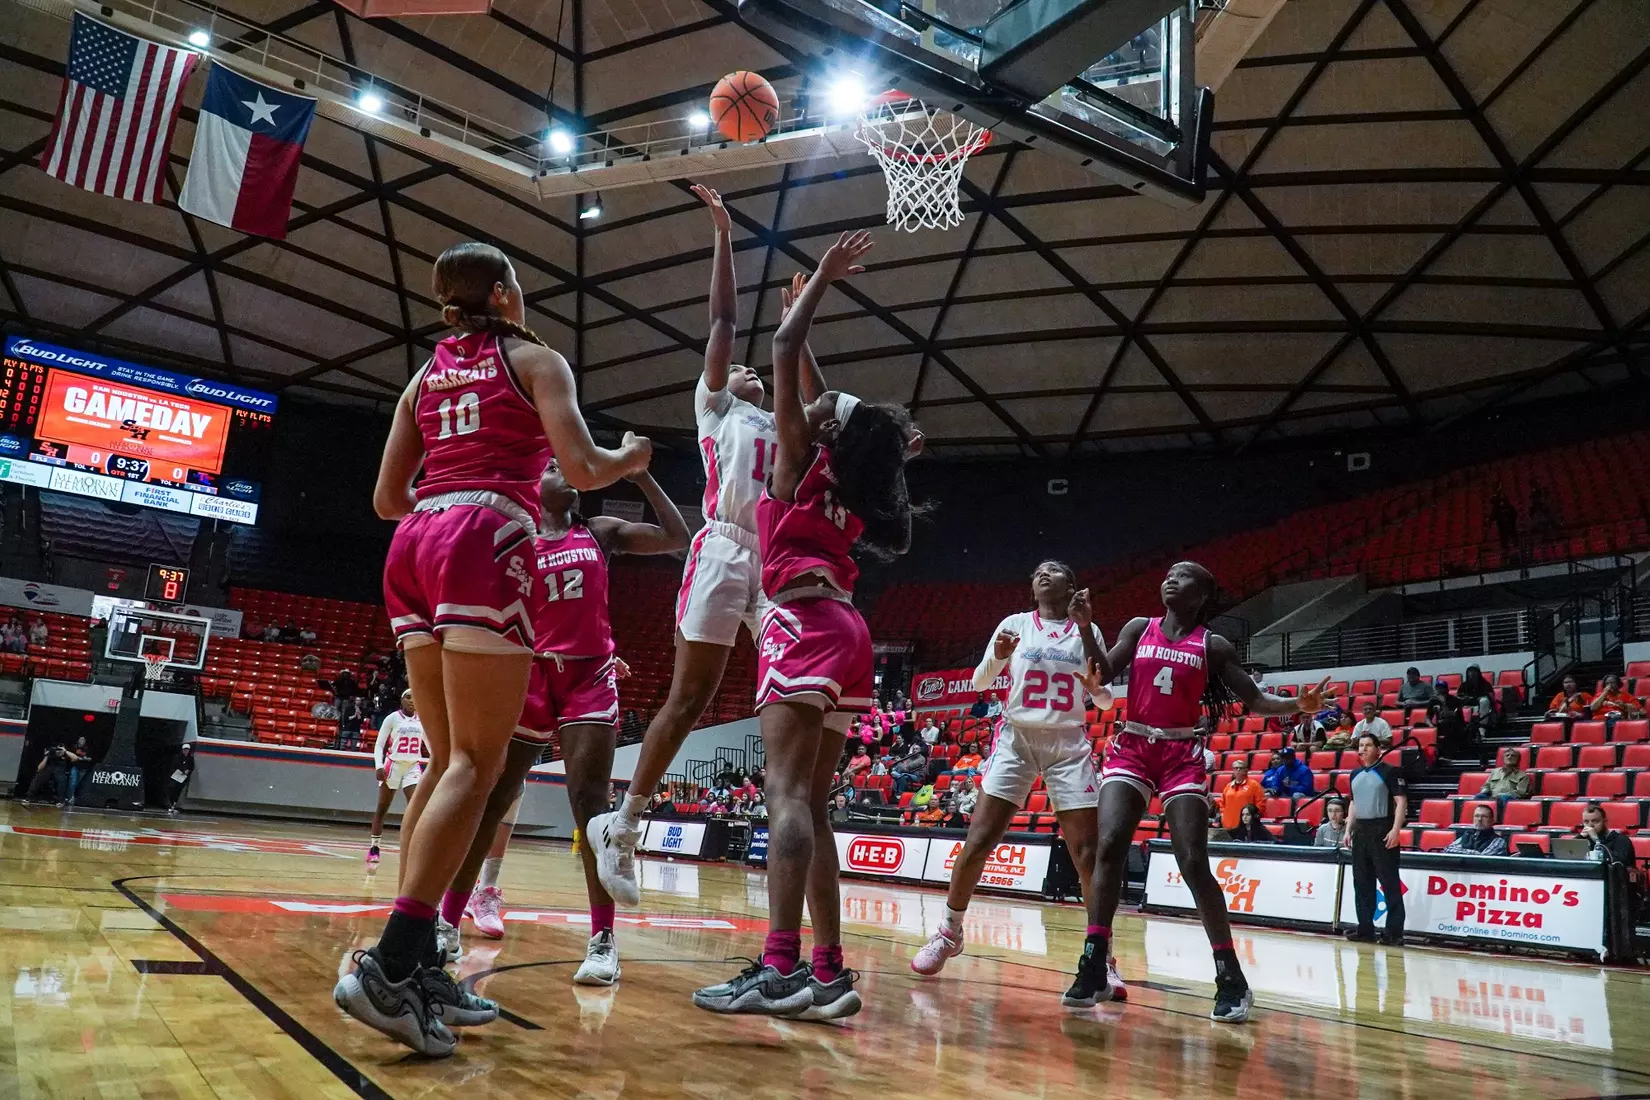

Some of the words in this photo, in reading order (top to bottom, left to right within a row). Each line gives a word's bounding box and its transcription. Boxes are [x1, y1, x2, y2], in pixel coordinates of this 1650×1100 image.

[4, 358, 18, 368] PLY
[20, 362, 28, 370] FL
[30, 364, 44, 374] PTS
[18, 344, 57, 360] BUD
[56, 354, 108, 370] LIGHT
[111, 370, 132, 380] DRINK
[117, 366, 134, 374] STAY
[144, 372, 156, 380] THE
[159, 398, 168, 406] LA
[170, 401, 190, 410] TECH
[192, 383, 225, 398] BUD
[224, 391, 272, 408] LIGHT
[64, 386, 212, 438] GAMEDAY
[258, 414, 272, 422] PTS
[437, 392, 480, 440] 10
[90, 452, 100, 464] 0
[116, 458, 149, 473] 9:37
[1347, 451, 1371, 472] D
[56, 472, 120, 492] MEMORIAL
[172, 468, 183, 479] 0
[54, 478, 118, 498] HERMANN
[146, 488, 172, 496] FIRST
[1047, 478, 1068, 496] C
[134, 490, 180, 504] FINANCIAL
[144, 500, 168, 508] BANK
[548, 548, 598, 568] HOUSTON
[160, 569, 184, 582] 9:37
[544, 568, 584, 602] 12
[1136, 645, 1154, 659] SAM
[1156, 646, 1204, 670] HOUSTON
[1153, 666, 1173, 696] 4
[1022, 670, 1075, 712] 23
[397, 736, 419, 754] 22
[92, 776, 140, 786] HERMANN
[94, 771, 140, 784] MEMORIAL
[668, 826, 682, 837] BUD
[662, 836, 682, 848] LIGHT
[1427, 876, 1580, 907] Domino's
[1456, 901, 1543, 928] Pizza
[1438, 923, 1460, 932] Order
[1462, 926, 1489, 936] Online
[1501, 930, 1560, 942] Dominos.com
